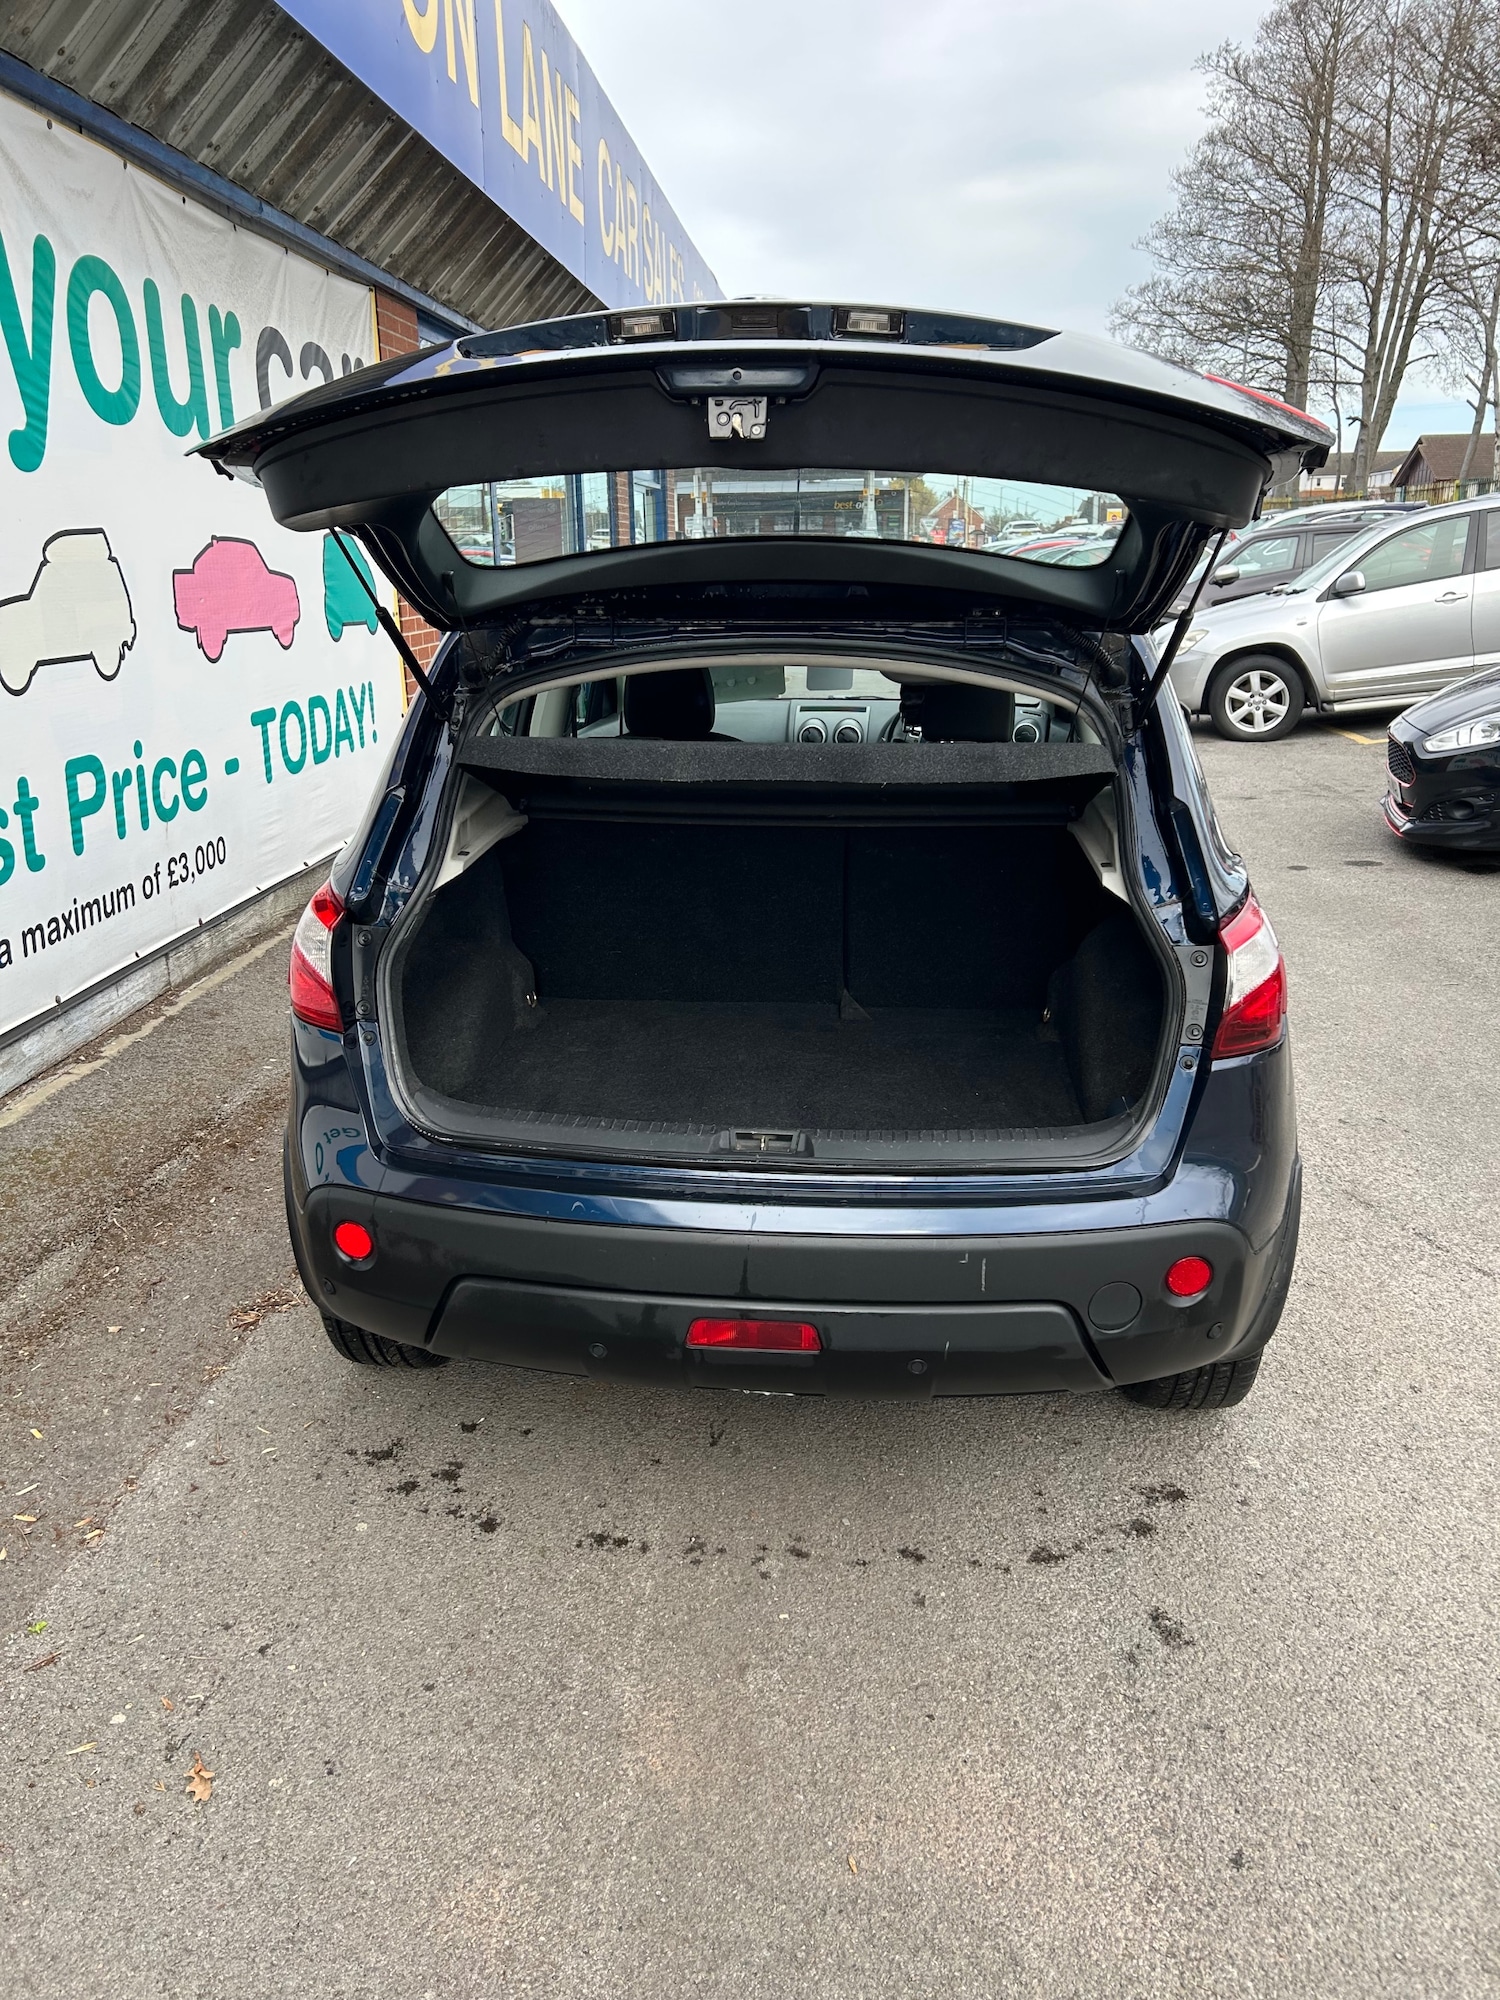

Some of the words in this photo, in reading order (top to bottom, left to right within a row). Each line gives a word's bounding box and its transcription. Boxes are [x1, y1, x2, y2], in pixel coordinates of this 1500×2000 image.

[494, 0, 585, 227] LANE
[598, 138, 639, 288] CAR
[0, 229, 241, 472] your
[65, 739, 208, 856] Price
[225, 757, 240, 776] -
[251, 681, 378, 784] TODAY!
[0, 937, 13, 969] a
[22, 882, 136, 958] maximum
[142, 863, 162, 900] of
[168, 836, 226, 888] £3,000
